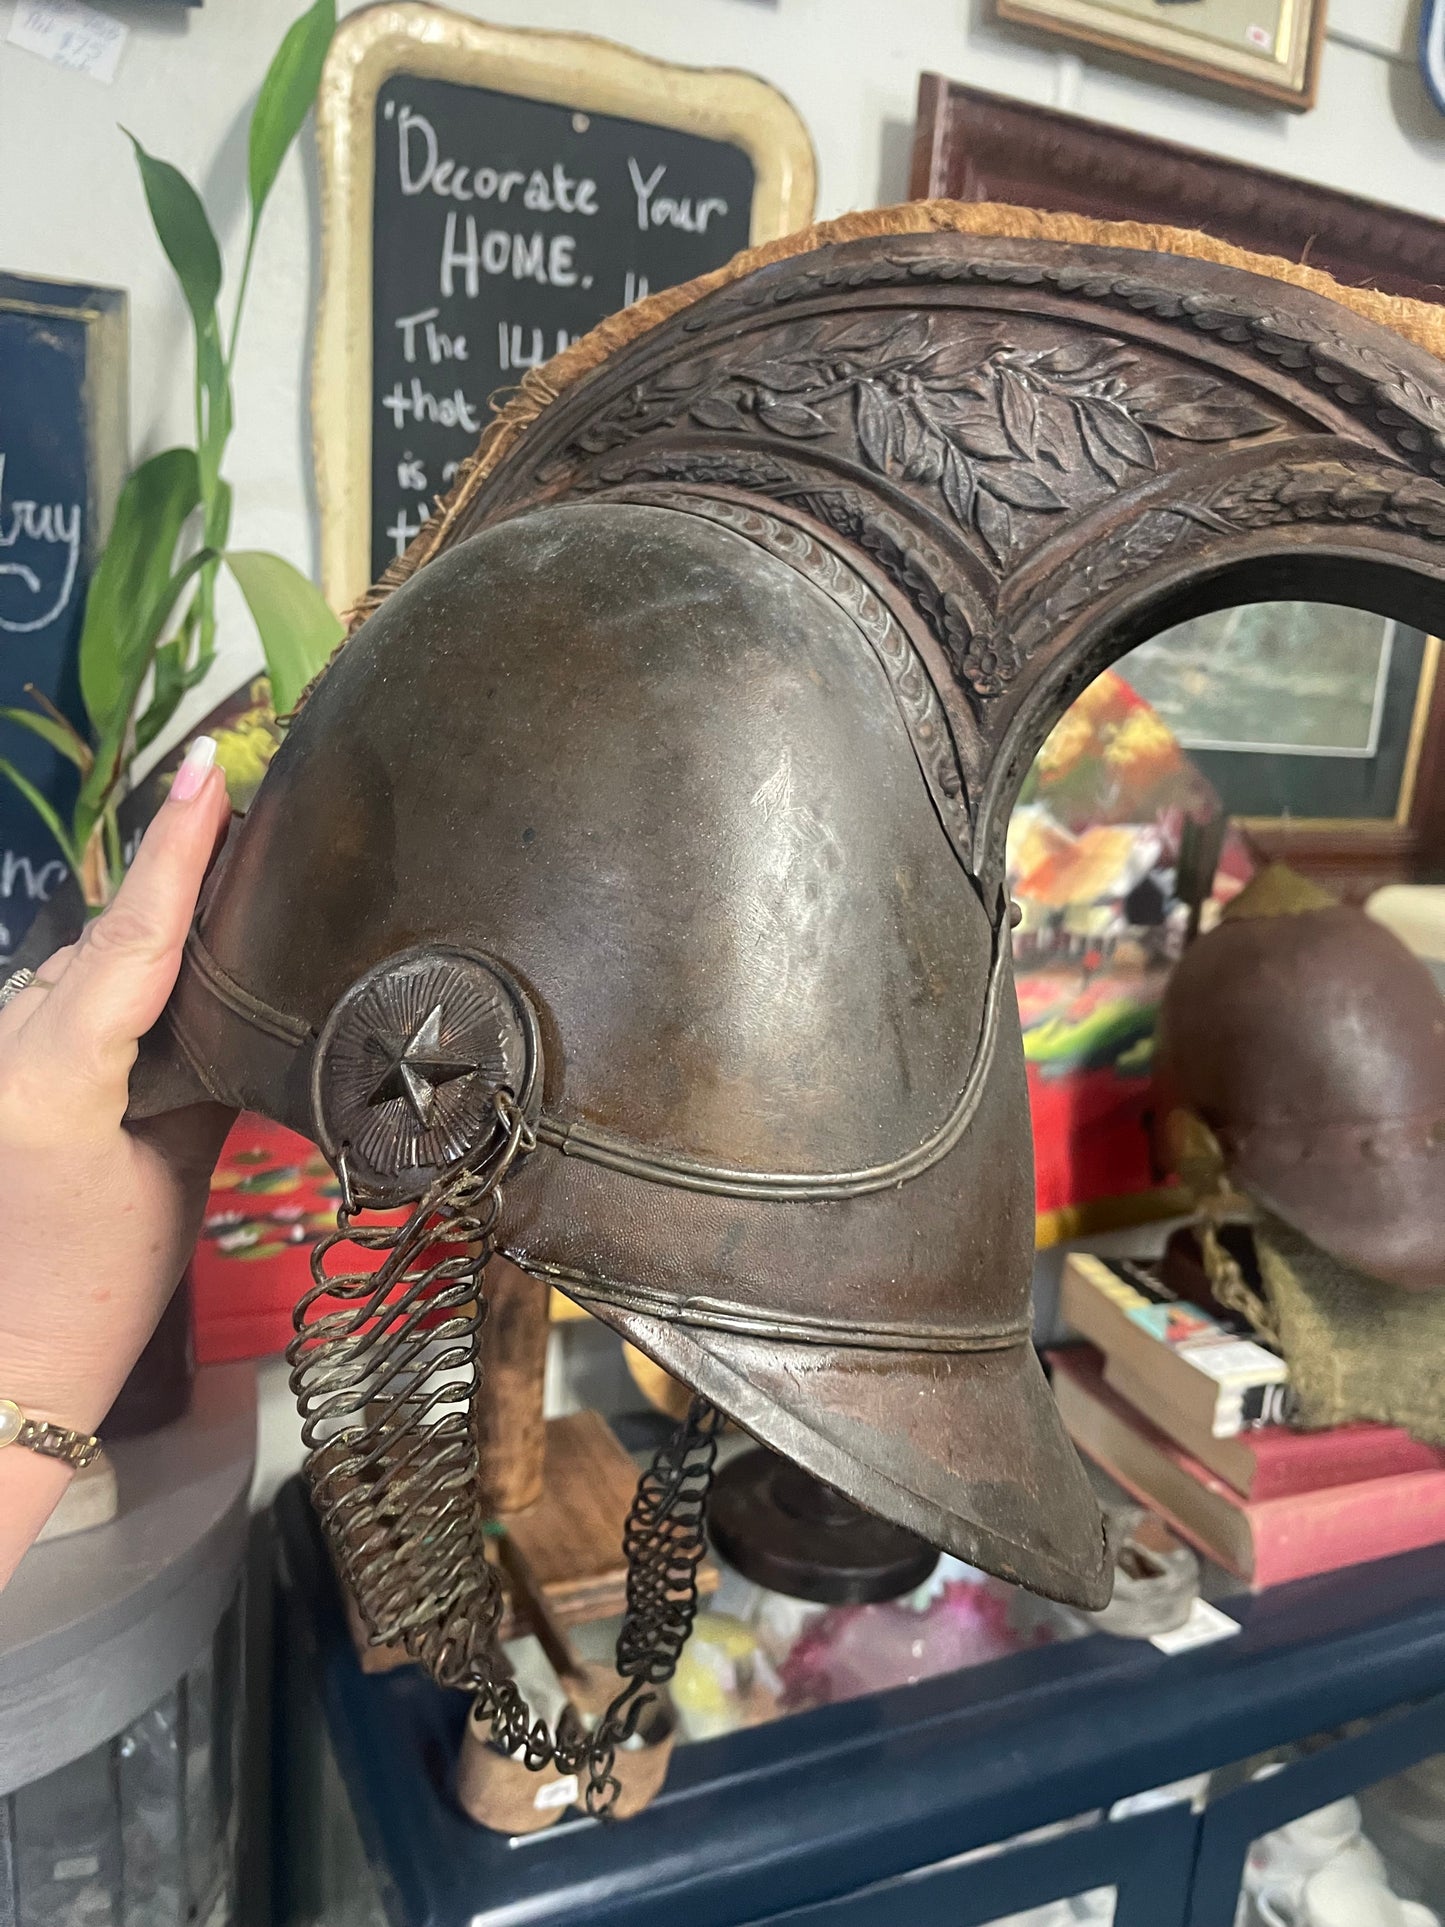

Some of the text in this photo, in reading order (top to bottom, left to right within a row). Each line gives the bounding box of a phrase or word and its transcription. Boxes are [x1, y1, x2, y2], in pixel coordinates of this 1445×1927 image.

[628, 156, 728, 234] Your
[440, 211, 595, 298] HOME.
[395, 307, 469, 364] The
[382, 377, 481, 434] that
[397, 450, 428, 490] is
